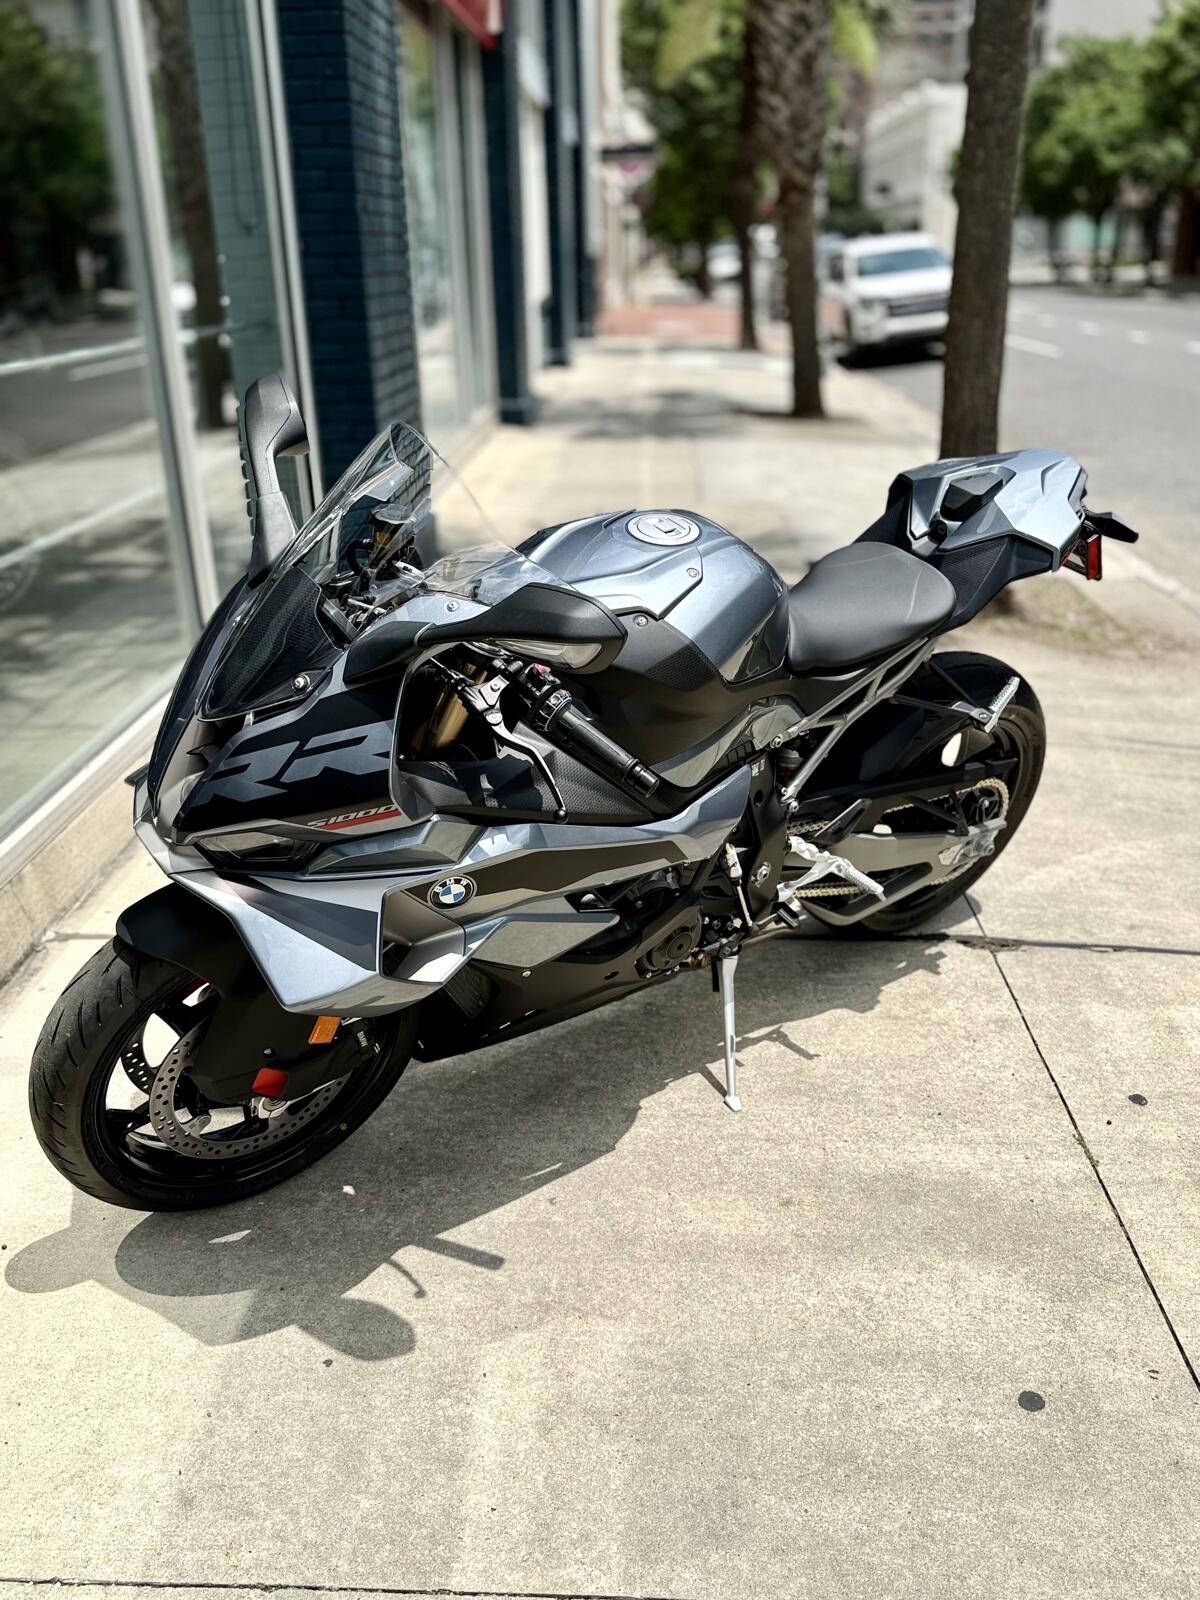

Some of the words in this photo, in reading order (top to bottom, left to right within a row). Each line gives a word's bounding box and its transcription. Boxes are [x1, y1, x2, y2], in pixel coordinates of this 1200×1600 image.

[191, 719, 395, 806] RR
[434, 878, 469, 893] BMW
[356, 1030, 368, 1048] BMW
